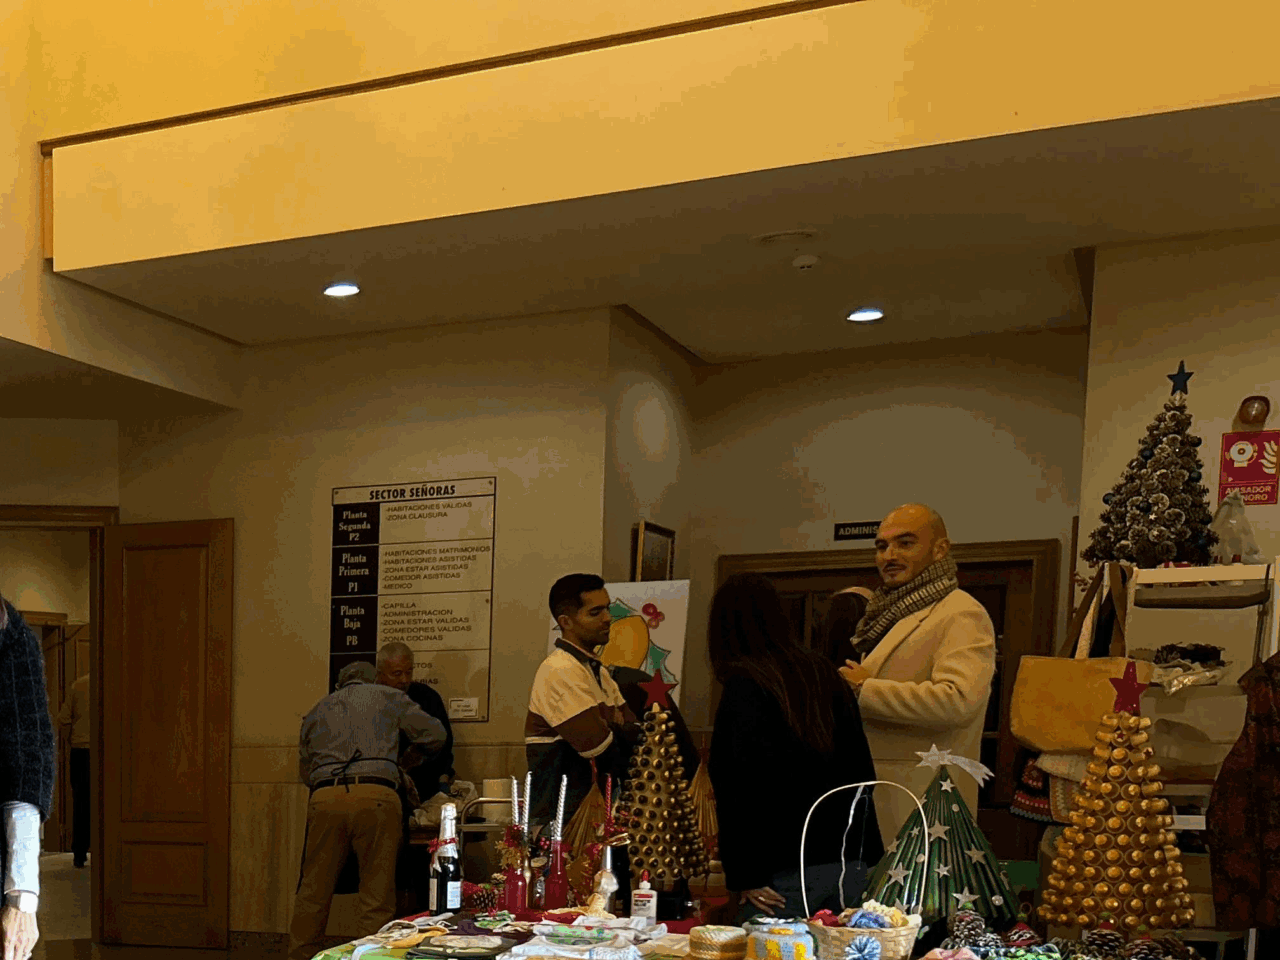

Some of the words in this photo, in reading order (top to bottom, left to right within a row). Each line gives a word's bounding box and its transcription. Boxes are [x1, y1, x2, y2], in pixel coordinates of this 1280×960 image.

[370, 489, 405, 500] SECTOR
[410, 485, 455, 498] SEÑORAS
[343, 511, 367, 519] Planta
[339, 521, 371, 532] Segunda
[342, 553, 367, 564] Planta
[338, 566, 369, 576] Primera
[348, 582, 358, 592] P1
[340, 605, 365, 616] Planta
[343, 618, 361, 630] Baja
[346, 636, 358, 646] PB
